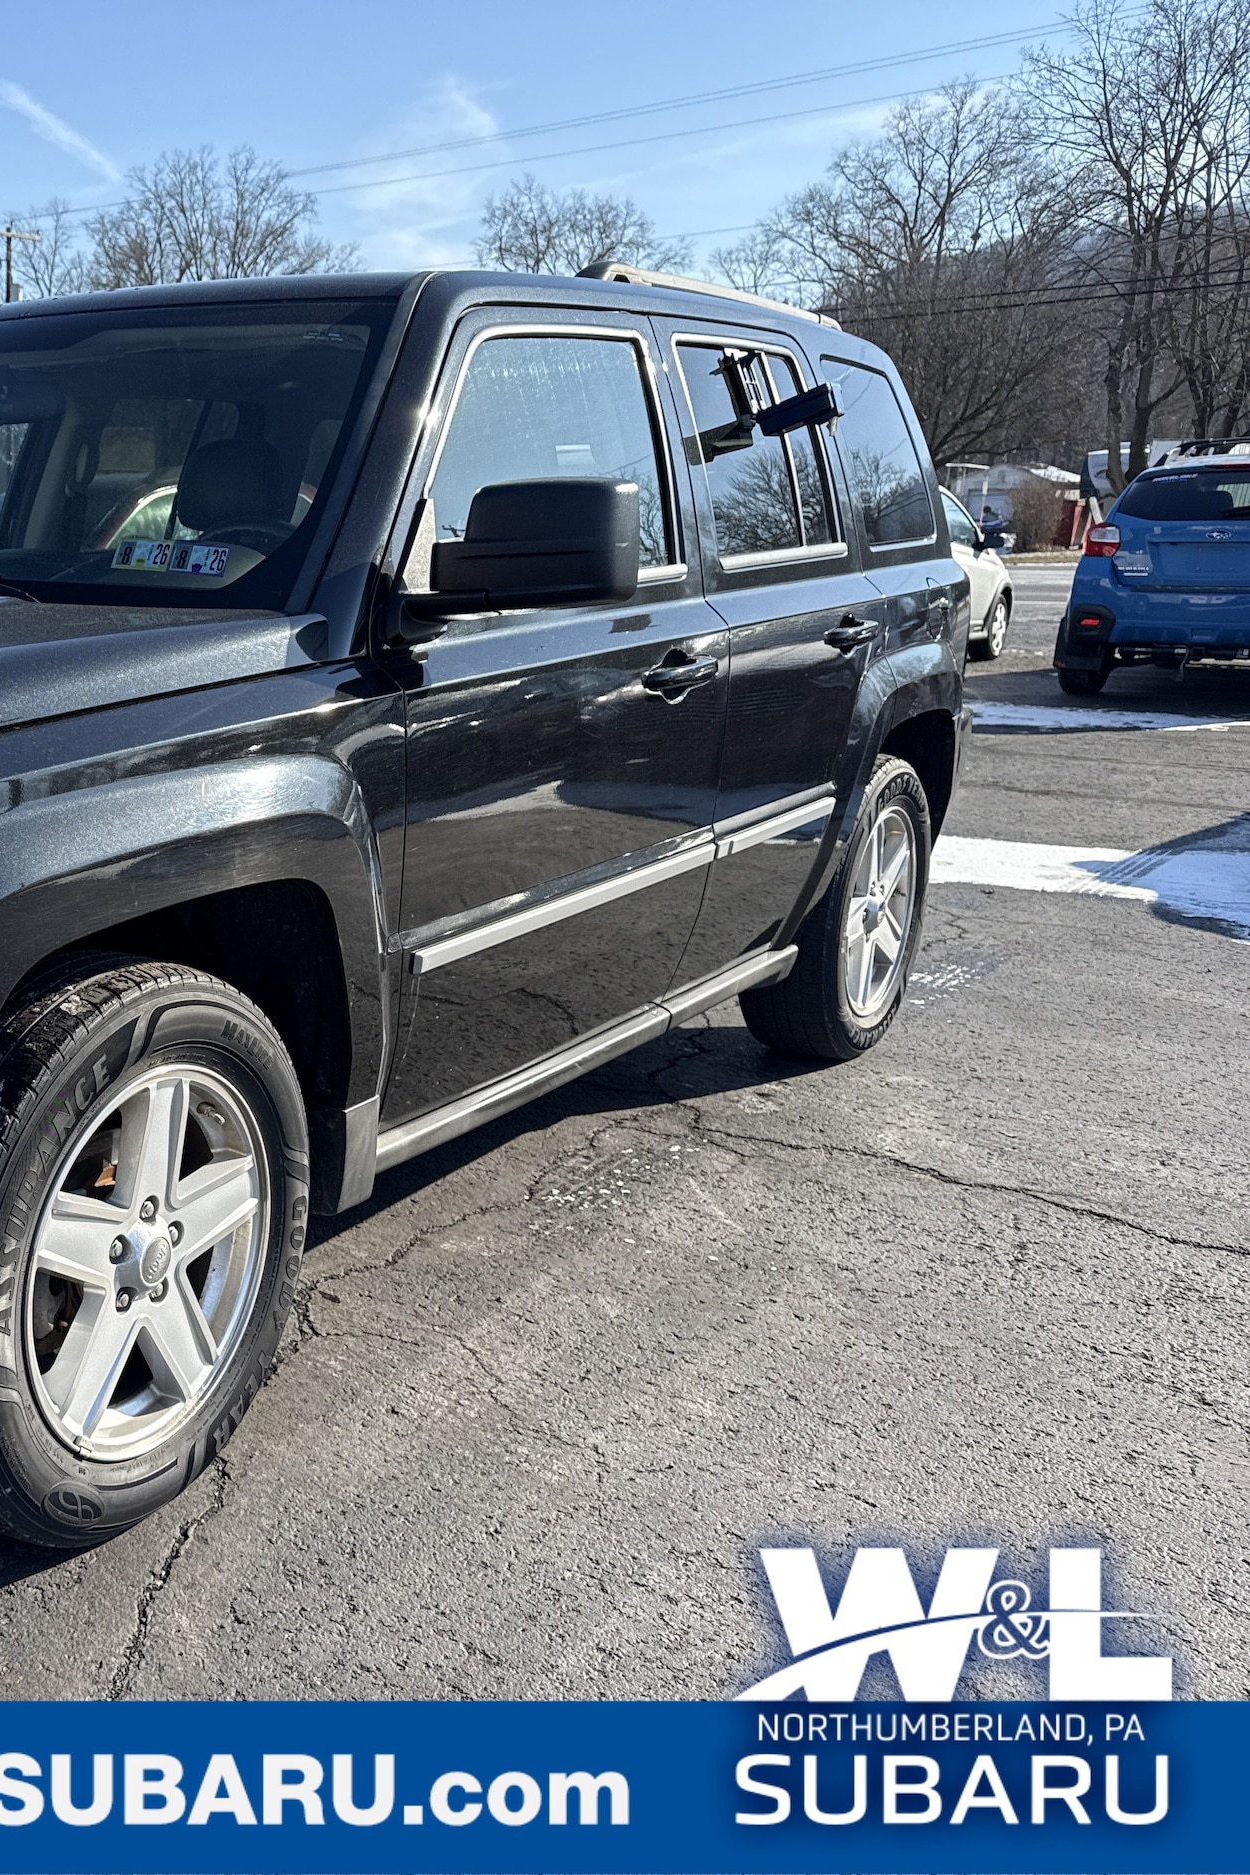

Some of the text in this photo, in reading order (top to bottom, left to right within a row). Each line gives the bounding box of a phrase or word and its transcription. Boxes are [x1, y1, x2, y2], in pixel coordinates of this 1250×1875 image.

[120, 546, 133, 565] 8
[152, 543, 170, 566] 26
[176, 549, 188, 570] 8
[209, 549, 227, 572] 26
